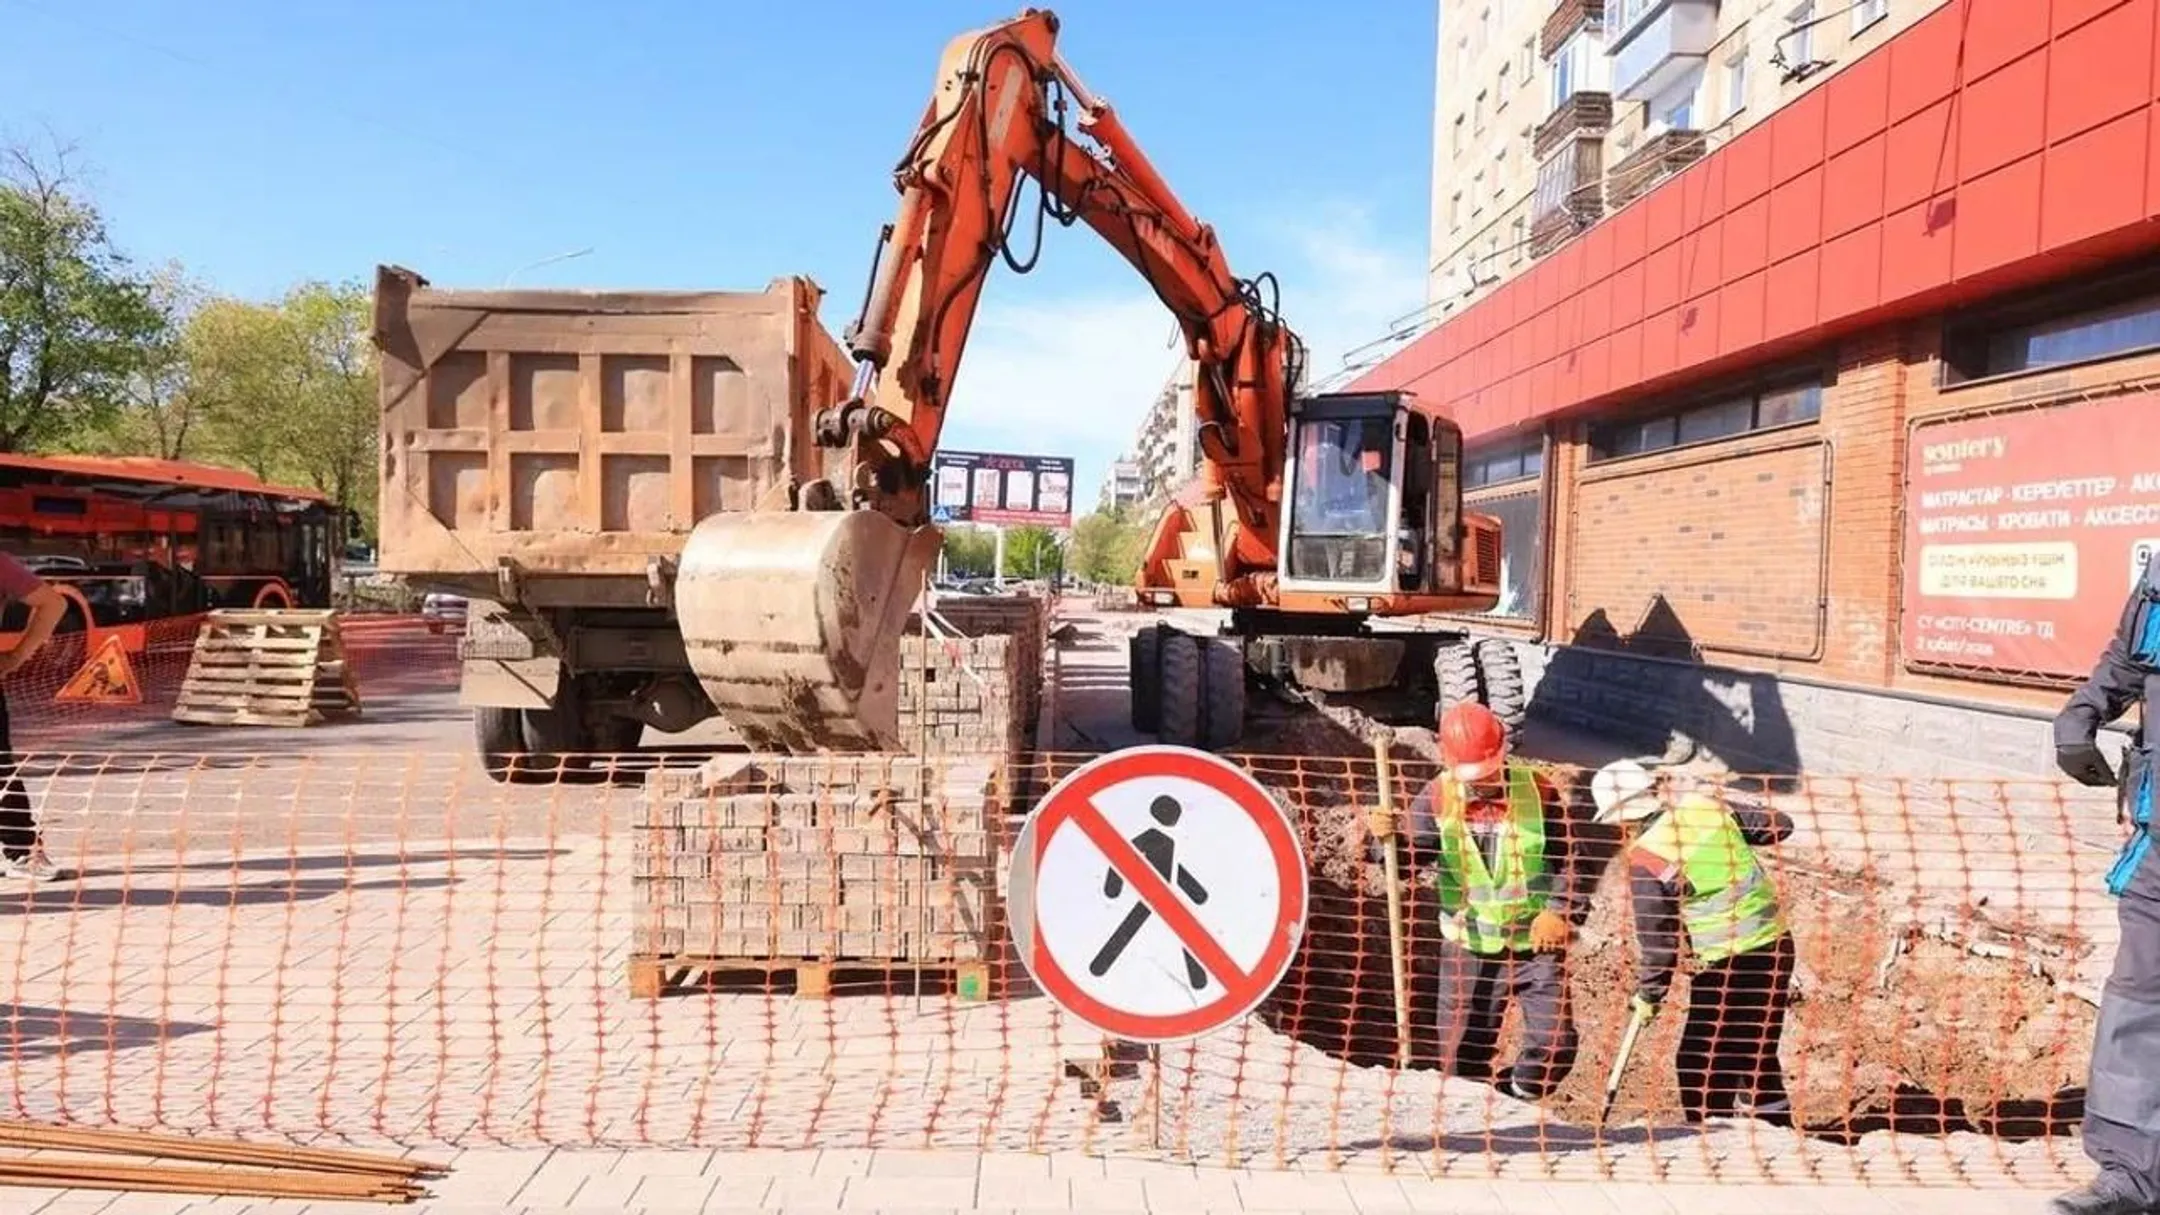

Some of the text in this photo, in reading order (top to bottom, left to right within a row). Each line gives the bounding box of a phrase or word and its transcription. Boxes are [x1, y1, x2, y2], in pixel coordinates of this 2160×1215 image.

[1921, 486, 2003, 508] МАТРАСТАР
[2011, 476, 2118, 502] КЕРЕУЕТТЕР
[1919, 513, 1990, 535] МАТРАСЫ
[1998, 508, 2071, 531] КРОВАТИ
